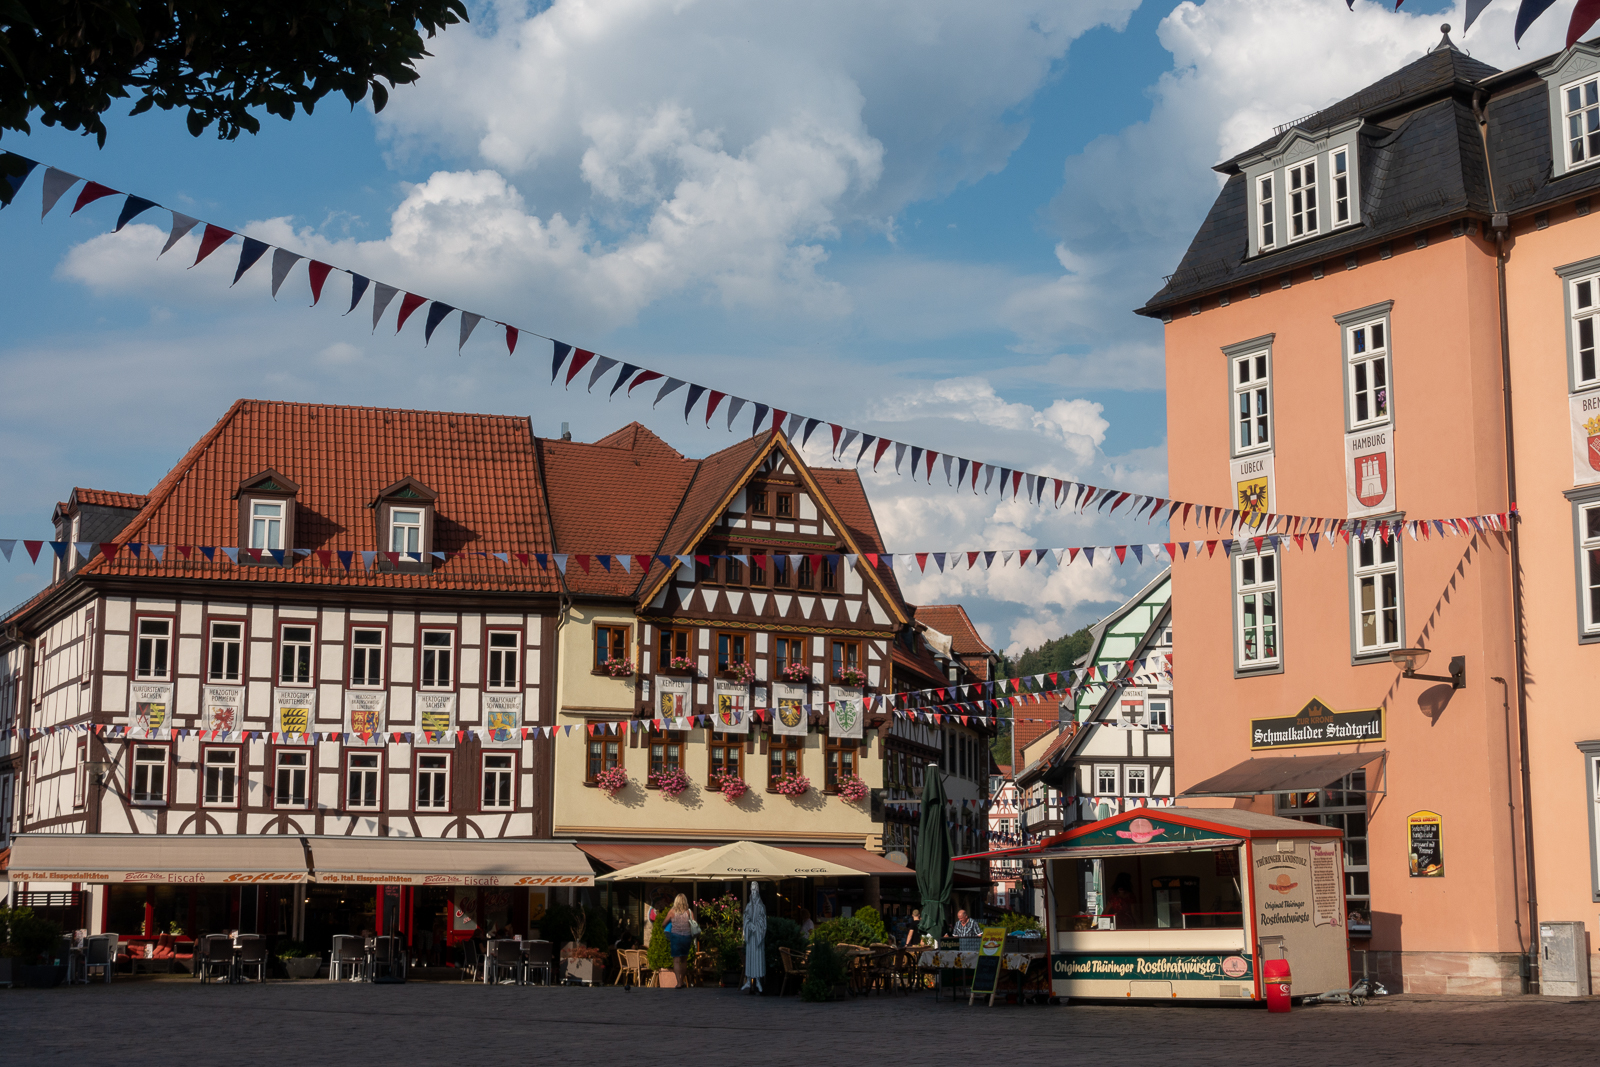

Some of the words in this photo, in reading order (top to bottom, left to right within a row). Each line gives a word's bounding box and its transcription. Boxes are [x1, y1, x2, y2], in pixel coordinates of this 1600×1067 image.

[1352, 433, 1386, 450] HAMBURG
[1240, 460, 1264, 474] LÜBECK
[1310, 716, 1334, 724] KRONE
[1254, 725, 1324, 745] Schmalkalder
[1326, 720, 1380, 738] Stadtgrill
[1256, 854, 1282, 868] THÜRINGER
[1282, 854, 1307, 866] LANDSTOLZ
[13, 872, 31, 880] orig.
[50, 872, 109, 880] Eisspezialitäten
[222, 872, 303, 883] Softeis
[514, 876, 590, 886] Softeis
[1264, 901, 1284, 911] Original
[1284, 900, 1305, 909] Thüringer
[1260, 912, 1310, 926] Rostbratwürste
[1054, 960, 1091, 976] Original
[1092, 960, 1134, 976] Thüringer
[1136, 958, 1216, 975] Rostbratwürste
